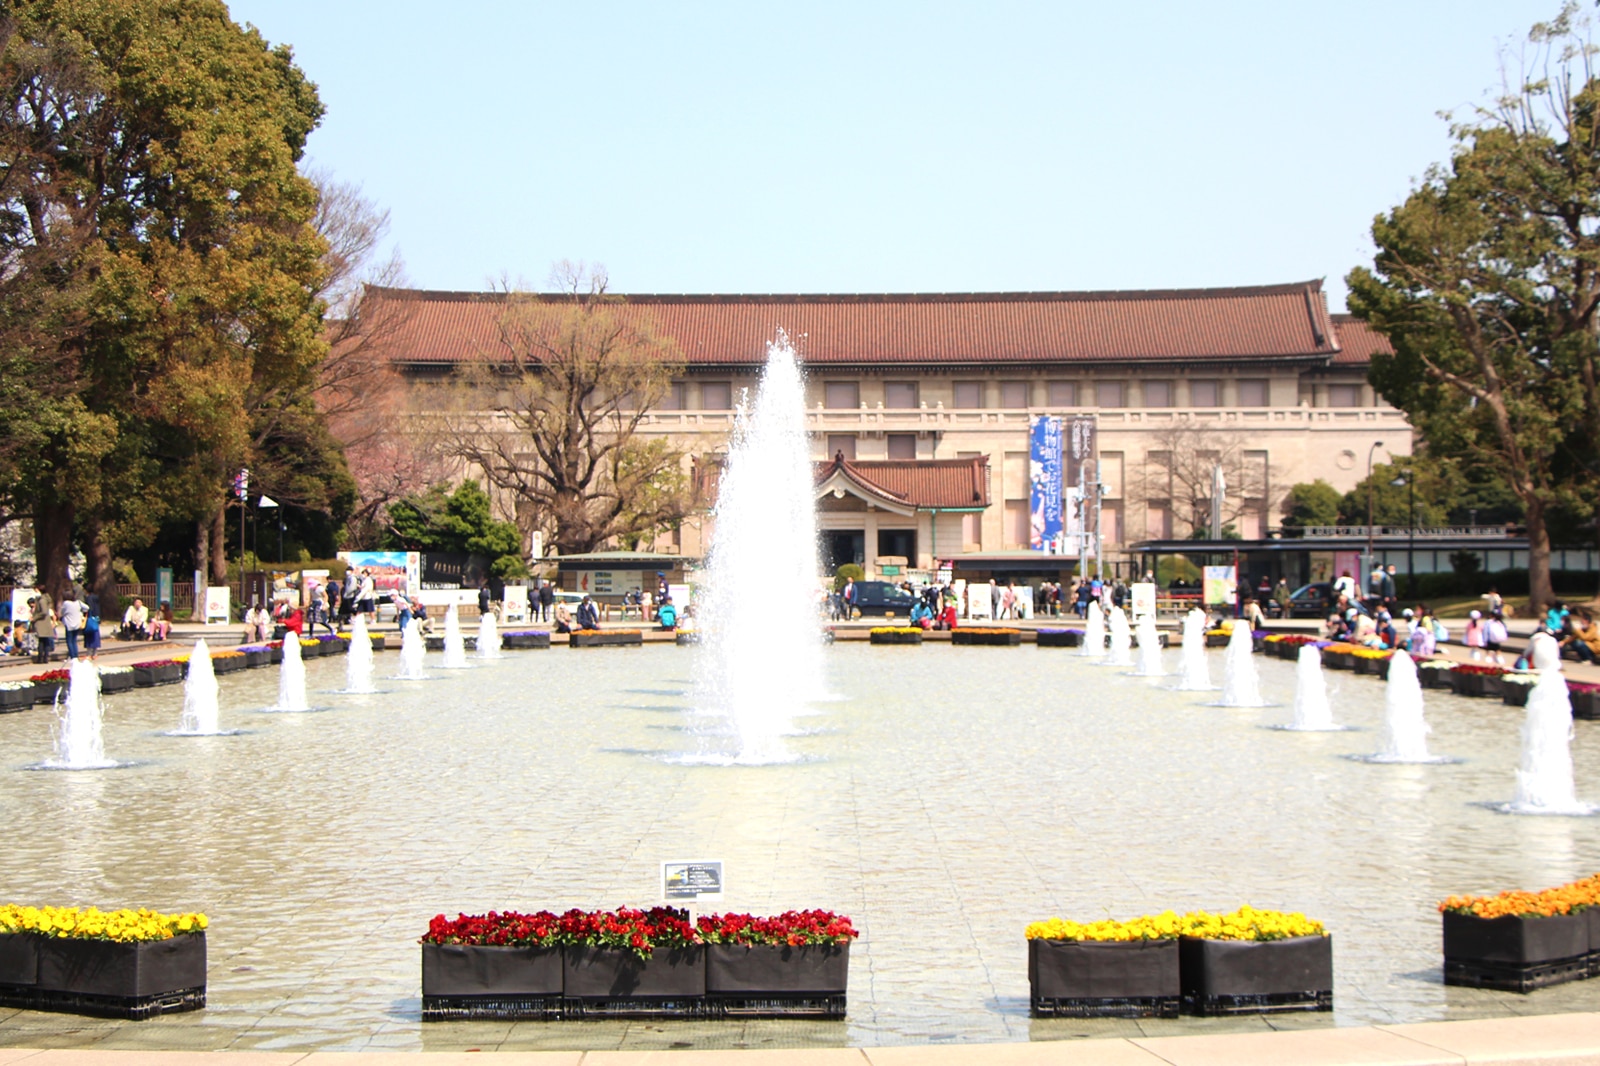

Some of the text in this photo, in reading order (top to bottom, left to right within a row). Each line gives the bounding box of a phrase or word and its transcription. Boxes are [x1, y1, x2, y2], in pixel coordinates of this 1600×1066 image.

[1044, 421, 1057, 522] 博物館でお花見を
